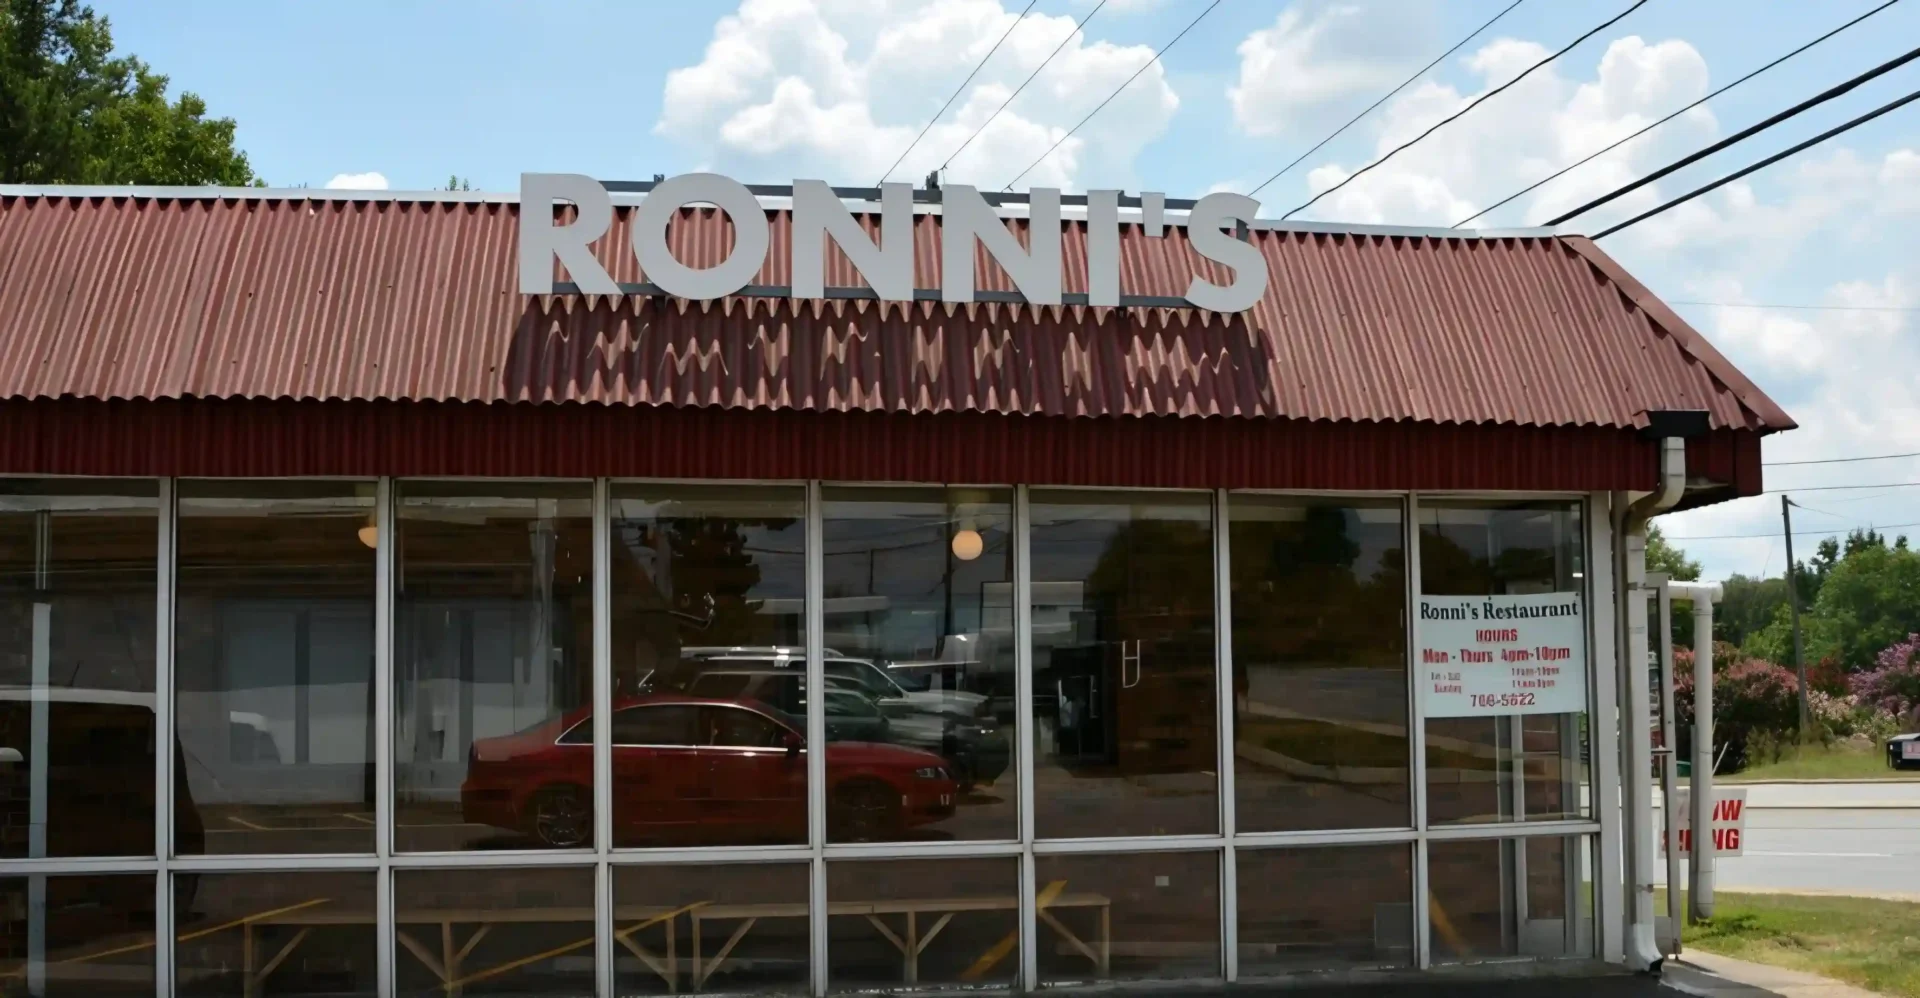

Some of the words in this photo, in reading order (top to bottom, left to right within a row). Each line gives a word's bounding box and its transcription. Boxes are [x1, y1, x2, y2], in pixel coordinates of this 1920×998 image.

[520, 172, 1267, 313] RONNI'S
[1421, 601, 1479, 620] Ronni's
[1483, 601, 1578, 620] Restaurant
[1475, 628, 1518, 642] HOURS
[1422, 648, 1449, 663] Mon
[1460, 648, 1493, 663] Thurs
